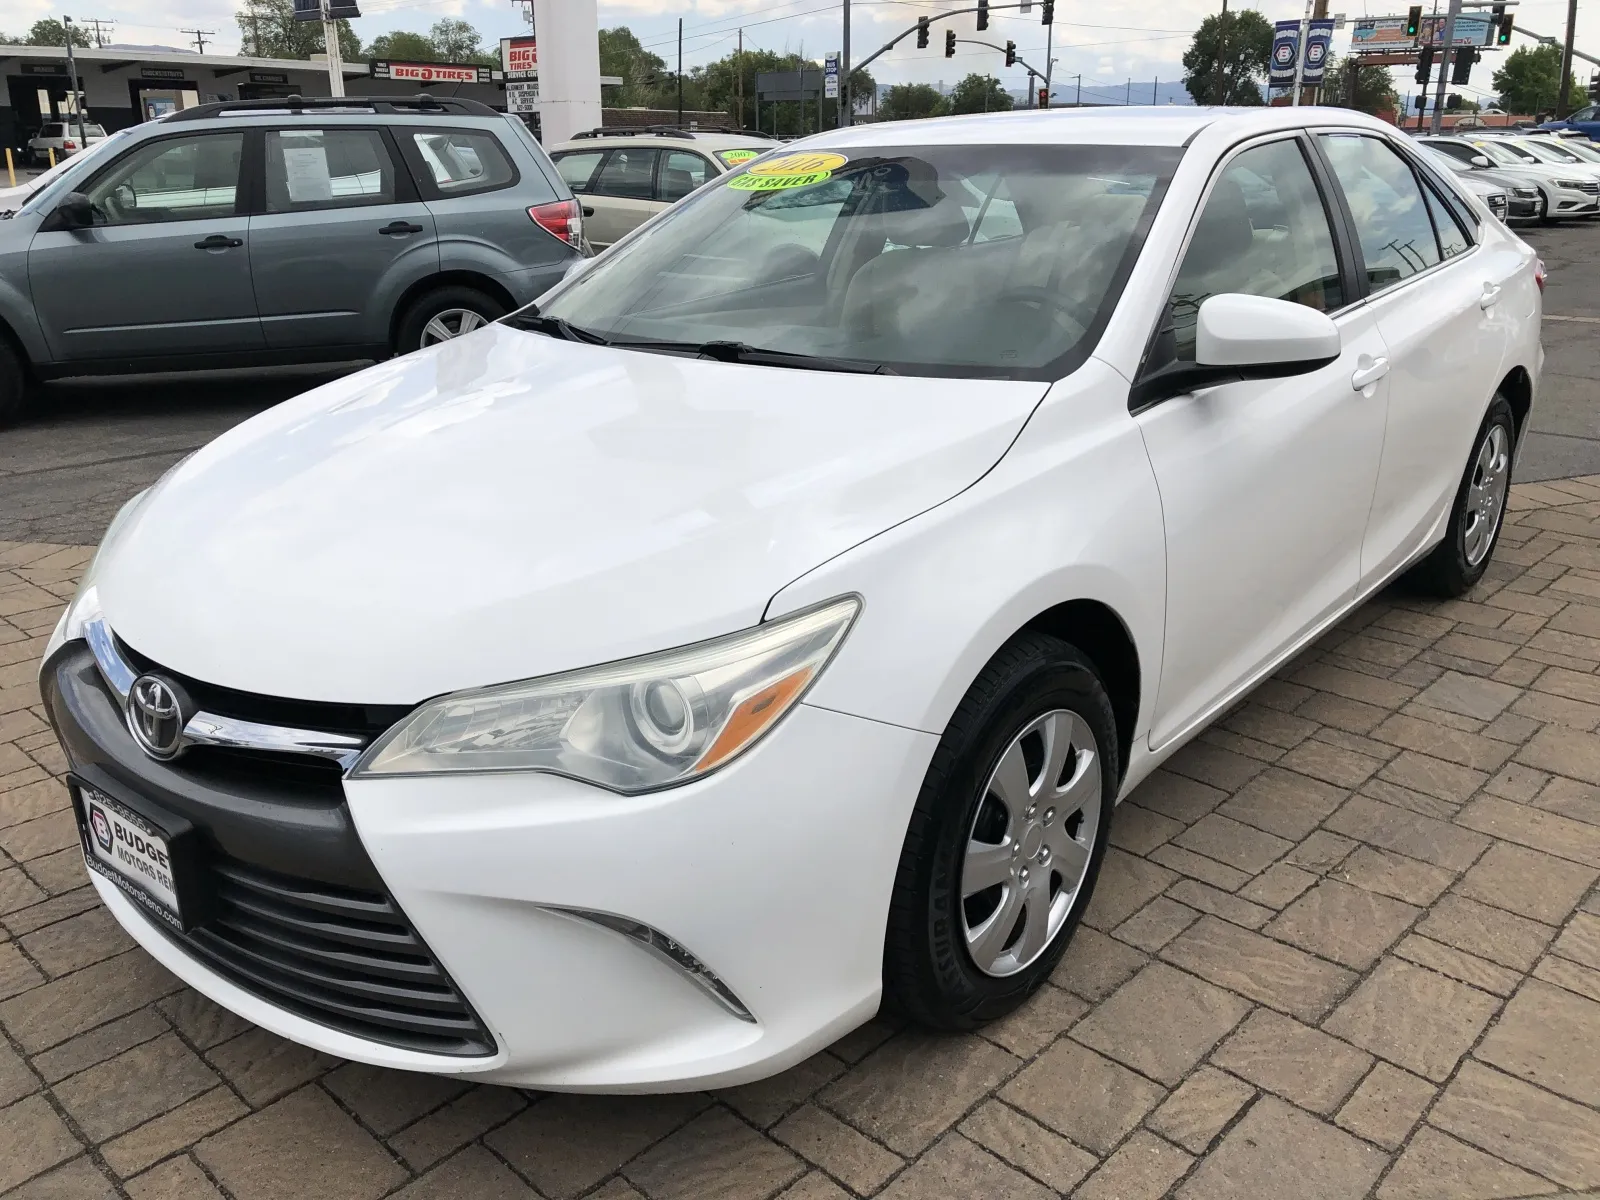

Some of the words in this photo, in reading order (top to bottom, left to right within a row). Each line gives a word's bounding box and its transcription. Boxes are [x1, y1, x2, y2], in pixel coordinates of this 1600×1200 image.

[509, 50, 530, 62] BIG
[509, 62, 532, 70] TIRES
[395, 68, 419, 77] BIG
[434, 70, 473, 80] TIRES
[507, 71, 526, 79] SERVICE
[728, 151, 751, 159] 2007
[756, 156, 834, 172] 2016
[731, 176, 761, 188] GAS
[758, 174, 818, 188] SAVER
[116, 844, 157, 881] MOTORS
[157, 870, 176, 896] REN
[86, 855, 183, 931] BudgetMotorsReno.com
